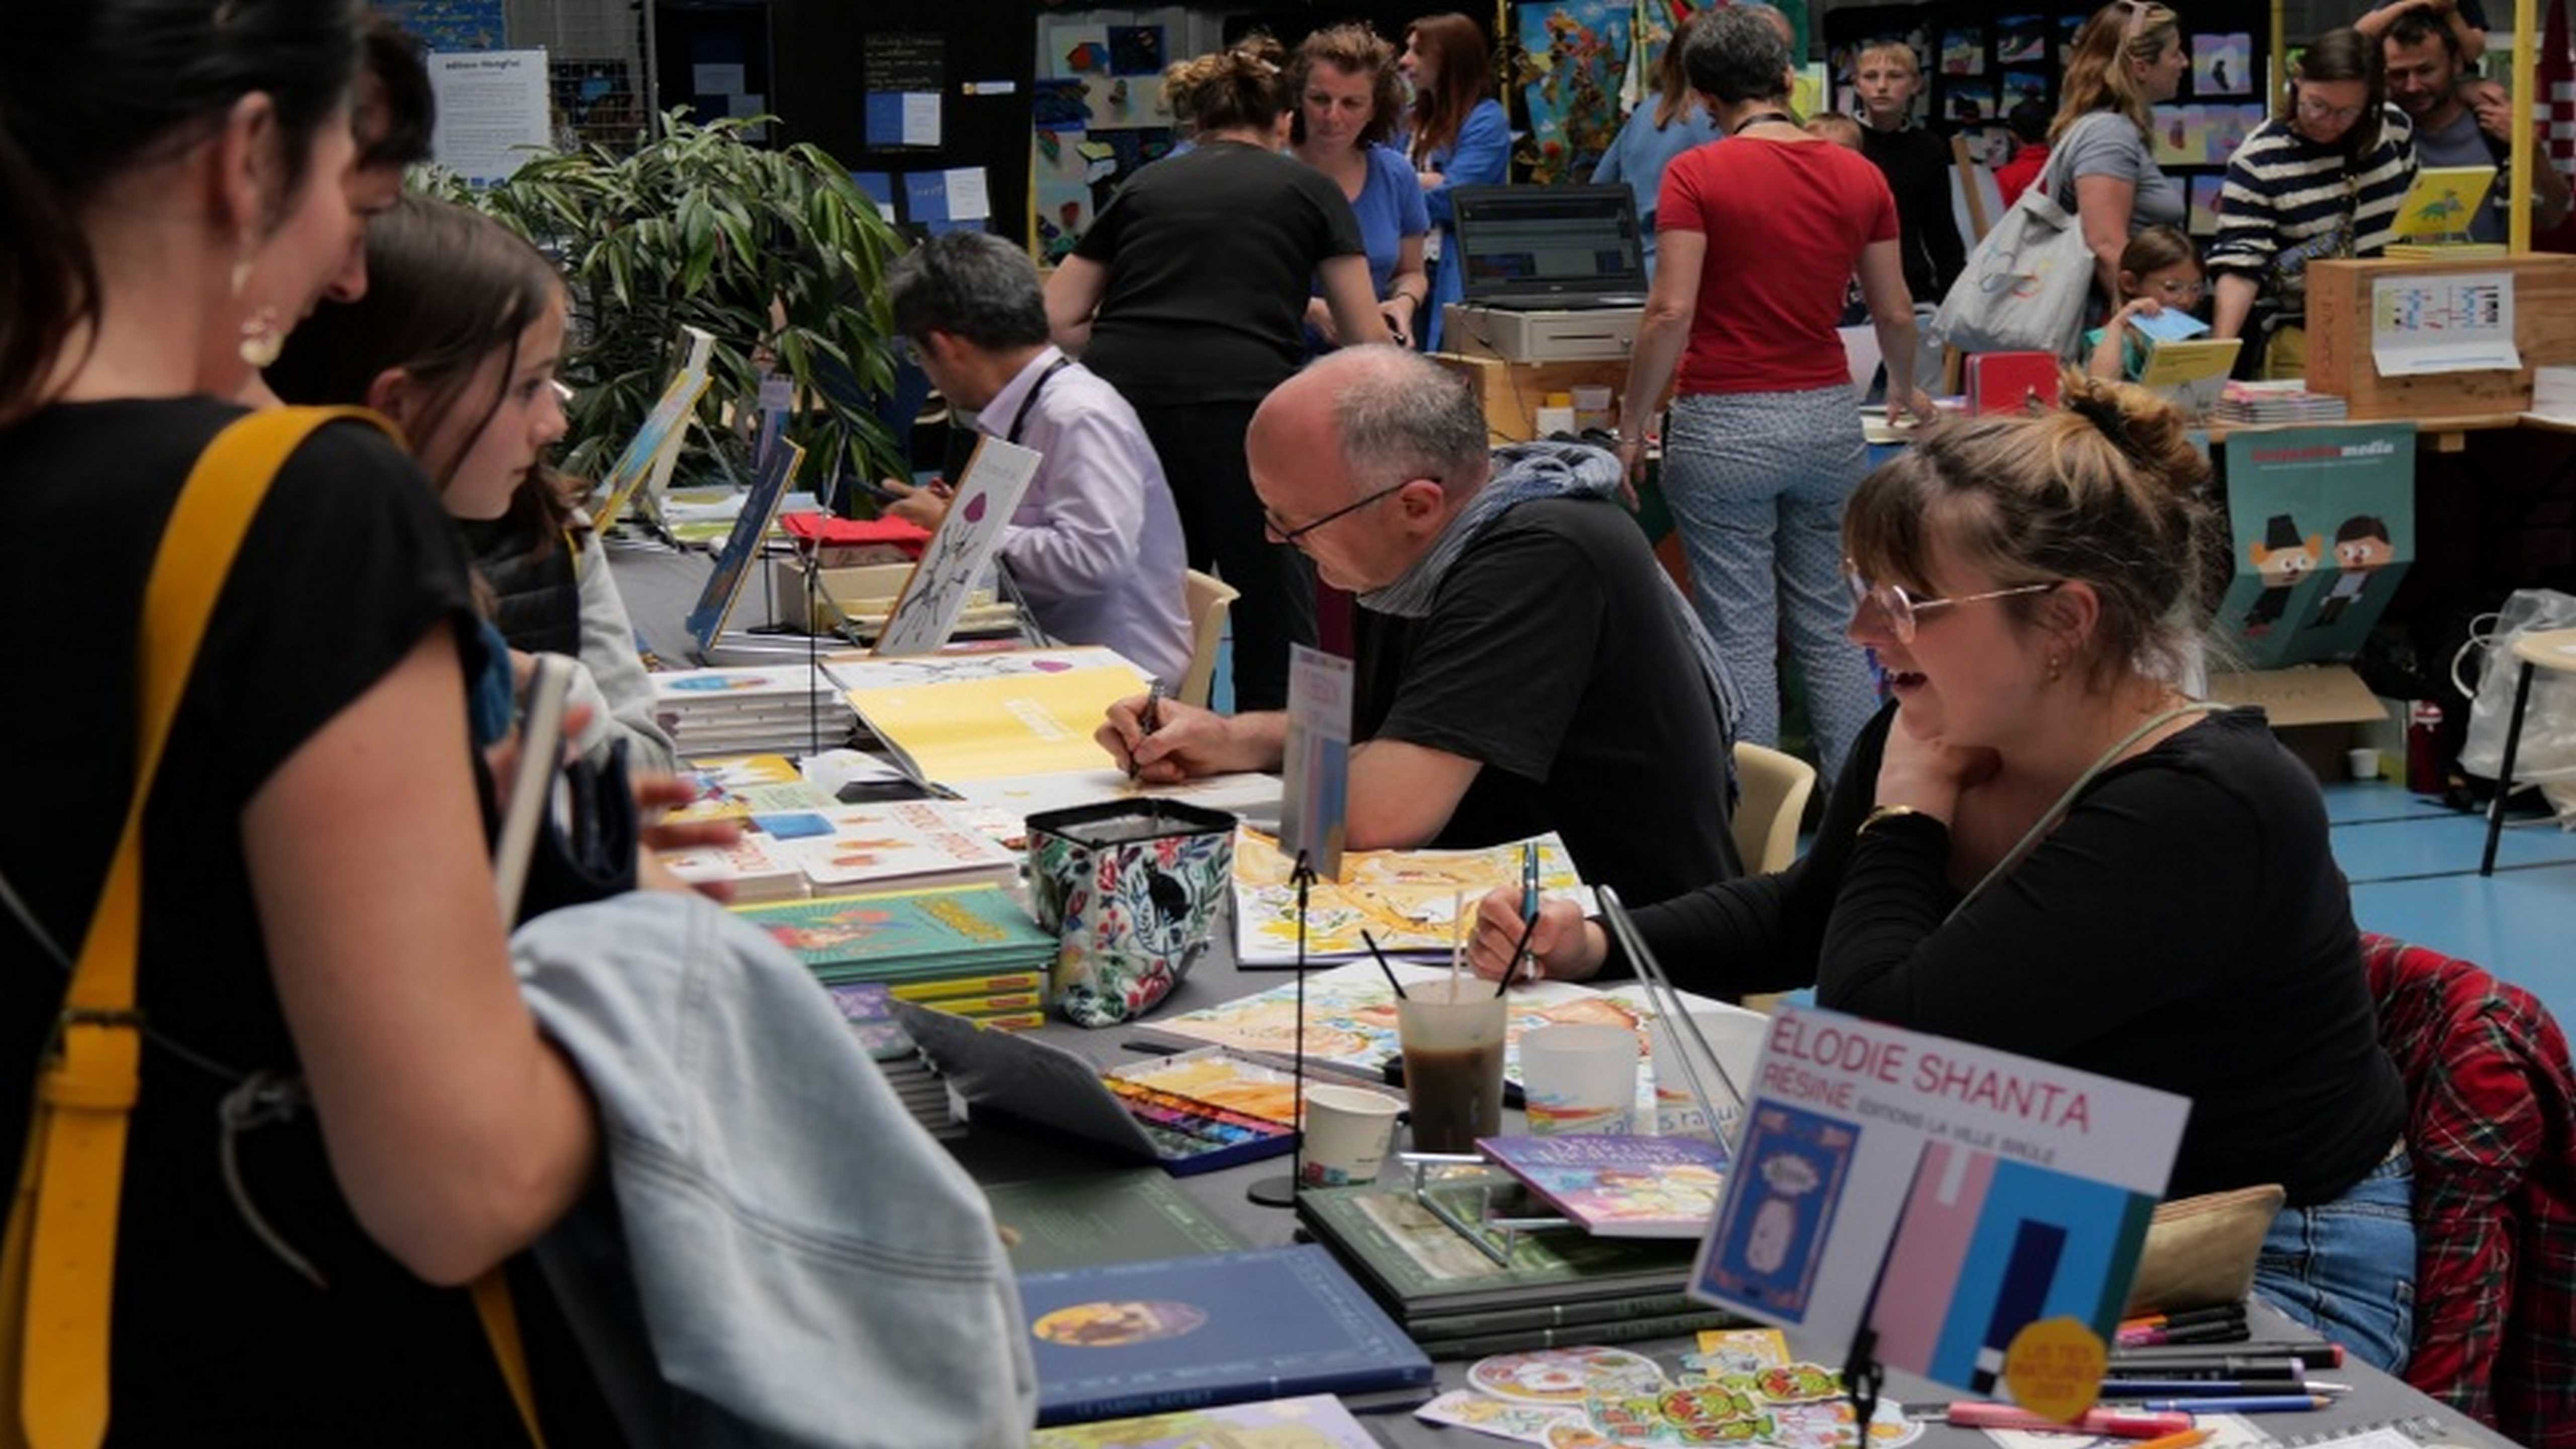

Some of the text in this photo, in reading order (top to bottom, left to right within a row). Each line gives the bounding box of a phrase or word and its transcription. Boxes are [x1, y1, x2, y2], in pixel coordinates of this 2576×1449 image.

[1762, 1061, 1856, 1110] RÉSINE
[1769, 1009, 2089, 1135] ÉLODIE SHANTA
